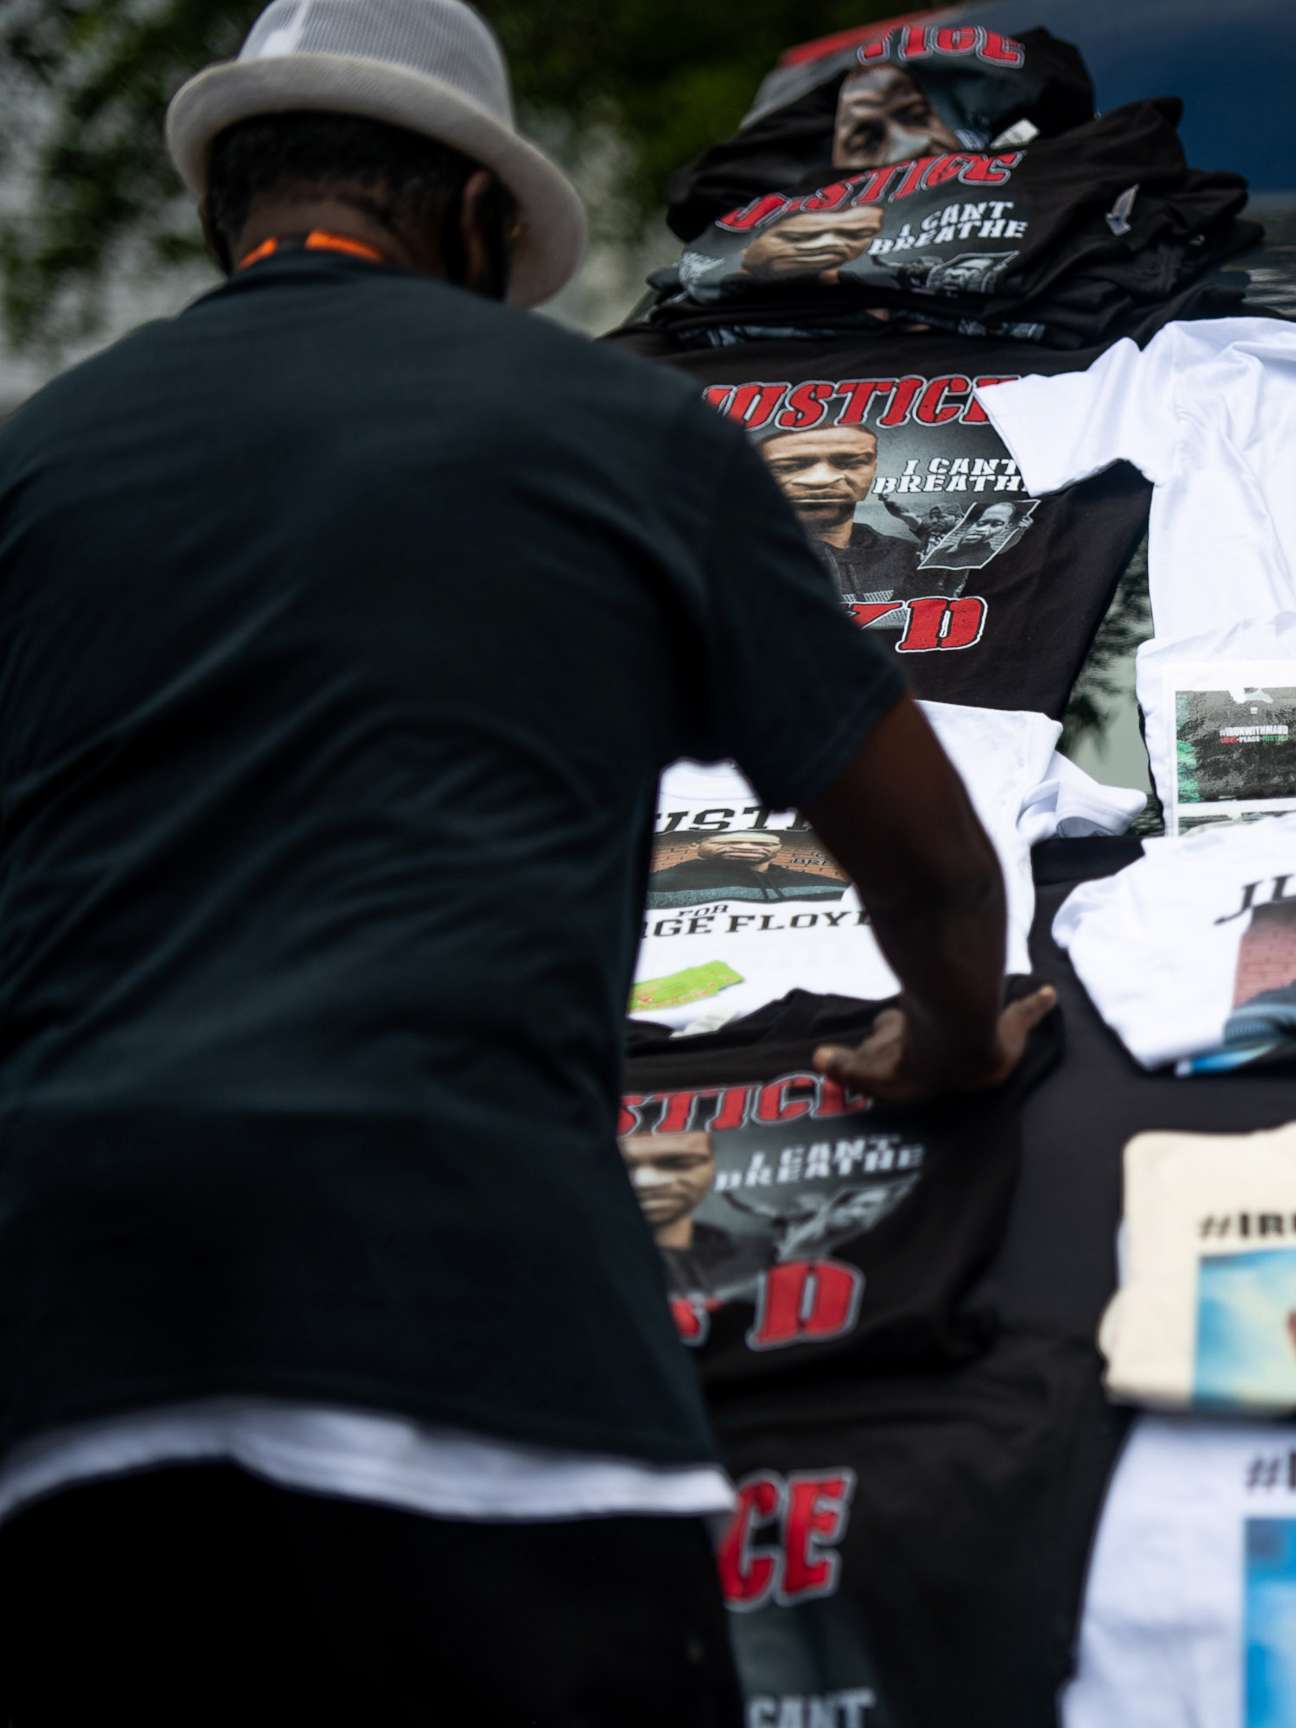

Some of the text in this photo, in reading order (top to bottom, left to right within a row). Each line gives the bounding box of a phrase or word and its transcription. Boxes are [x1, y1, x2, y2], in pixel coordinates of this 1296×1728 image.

[868, 219, 1029, 256] BREATHE
[903, 458, 920, 476] I
[871, 475, 1031, 495] BREATH
